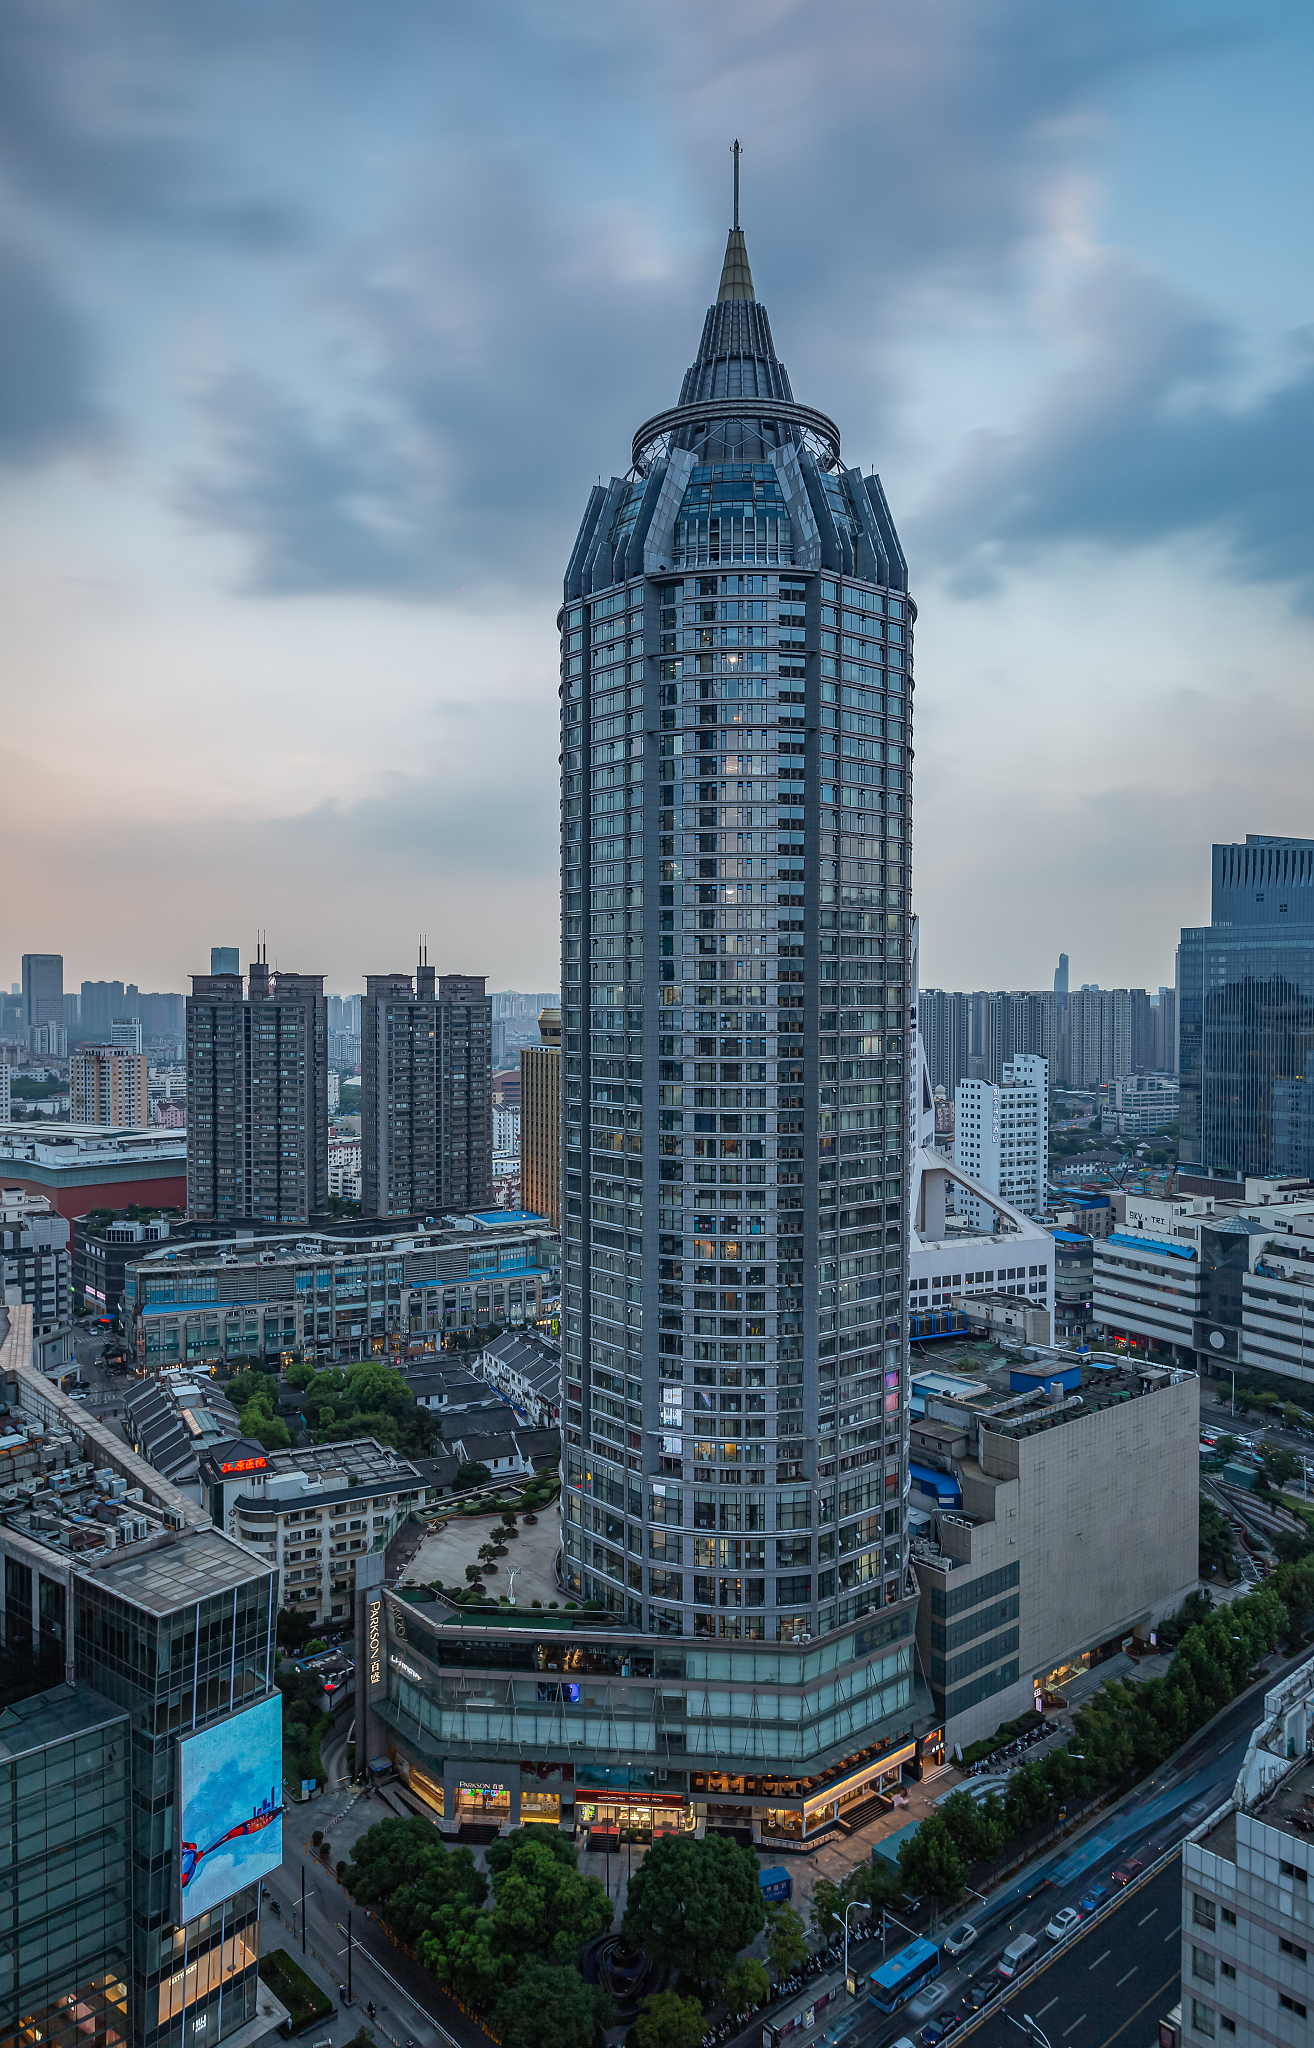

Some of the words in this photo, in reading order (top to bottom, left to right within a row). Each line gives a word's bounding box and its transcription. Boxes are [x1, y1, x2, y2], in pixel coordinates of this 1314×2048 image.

[221, 1456, 267, 1474] 江原医院
[369, 1600, 381, 1660] PARKSON
[370, 1659, 381, 1685] 百盛
[459, 1781, 490, 1790] PARKSON
